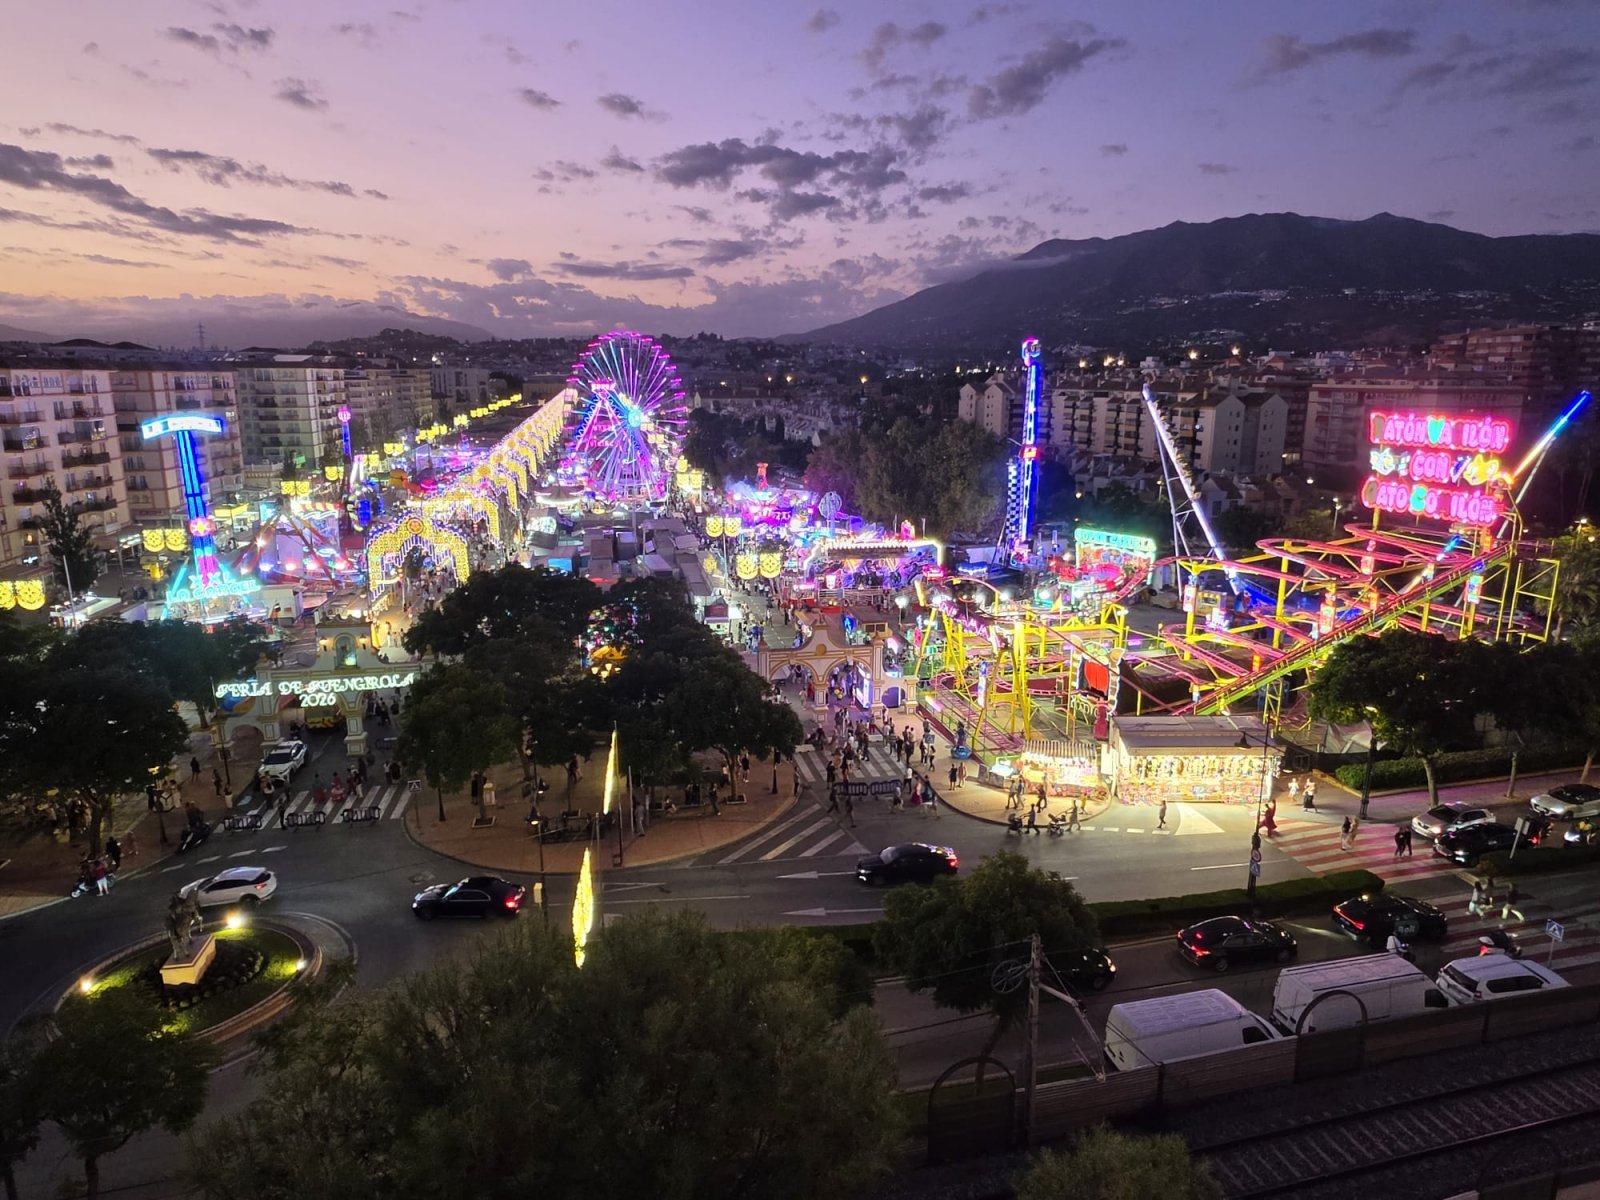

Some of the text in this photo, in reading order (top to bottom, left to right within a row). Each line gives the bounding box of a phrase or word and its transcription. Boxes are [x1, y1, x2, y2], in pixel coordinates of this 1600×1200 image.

[1372, 413, 1506, 449] ATÓN VAILÓN
[1412, 452, 1449, 481] CON
[1366, 481, 1495, 522] ATO COILÓN
[188, 572, 234, 589] XXL
[216, 673, 415, 698] FERIA DE FUENGIROLA
[299, 694, 337, 707] 2026
